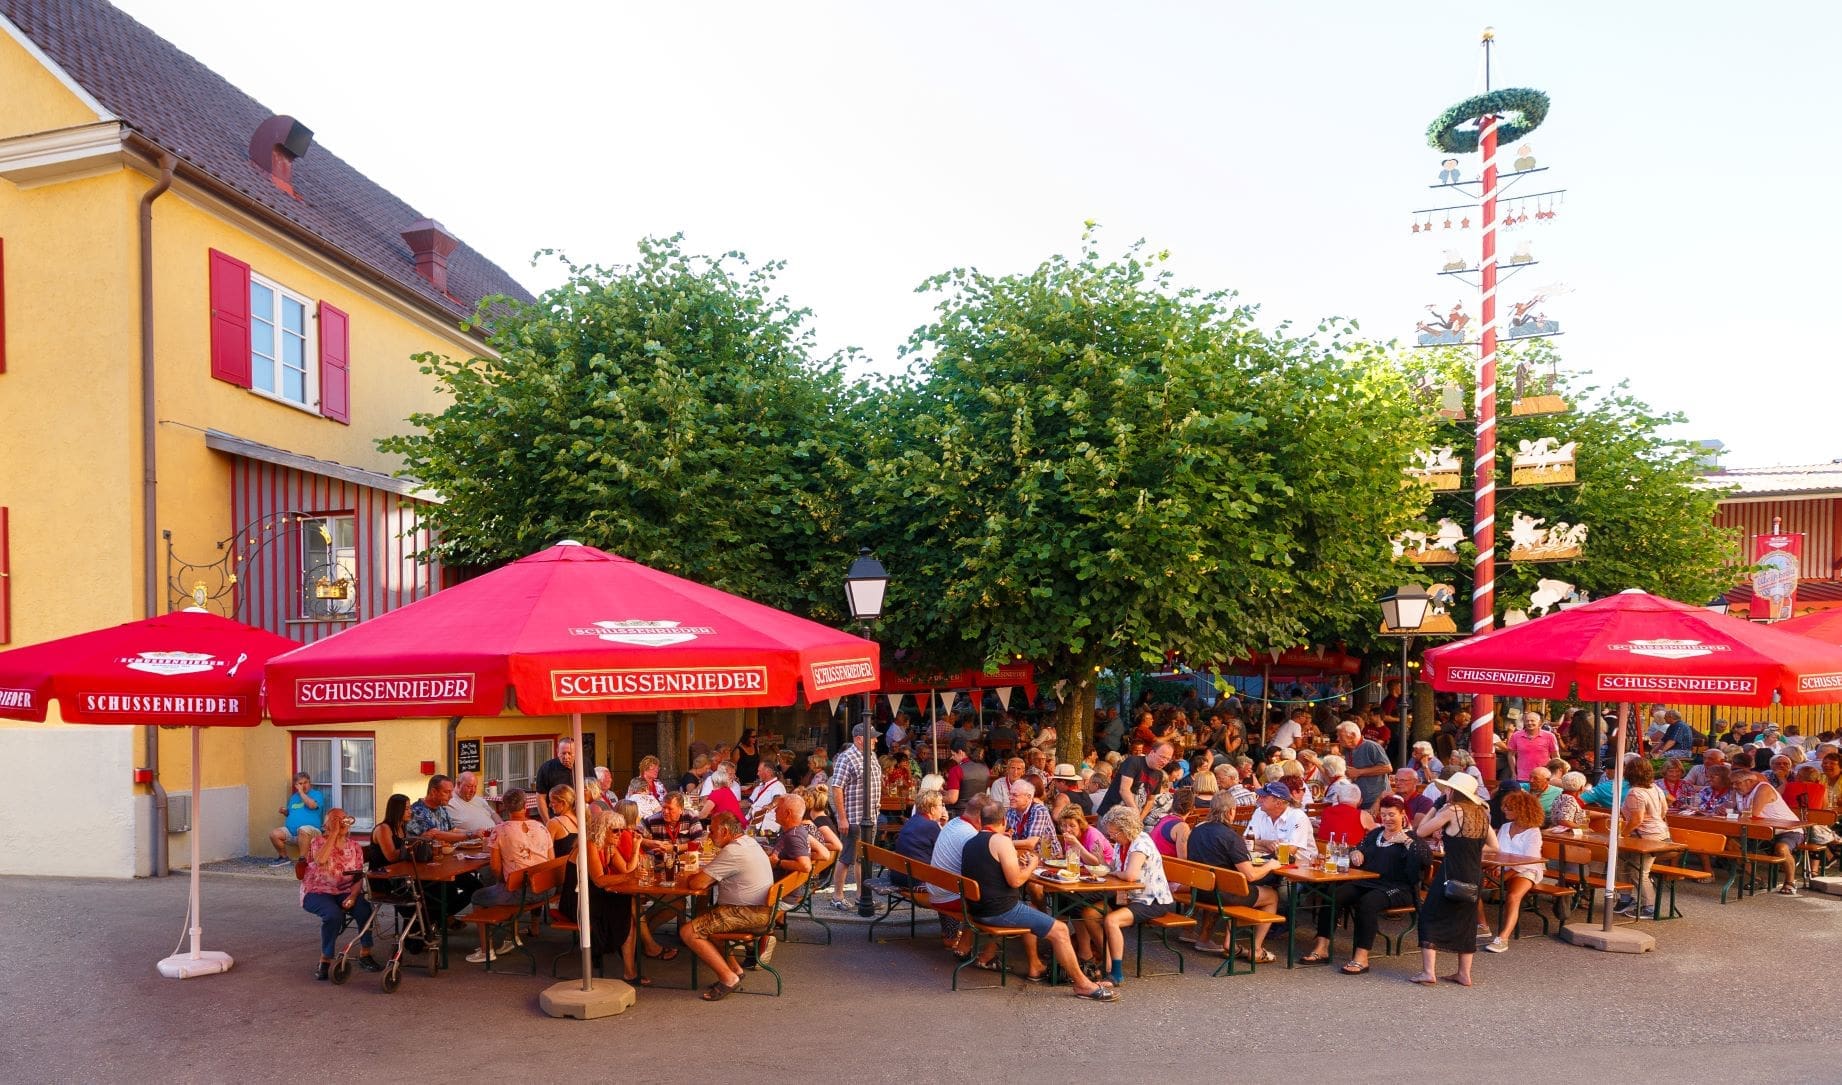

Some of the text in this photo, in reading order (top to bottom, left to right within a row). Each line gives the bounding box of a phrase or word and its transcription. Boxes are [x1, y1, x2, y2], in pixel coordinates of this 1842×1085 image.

[560, 672, 761, 695] SCHUSSENRIEDER
[815, 662, 872, 685] SCHUSSENRIEDER
[1451, 669, 1550, 685] SCHUSSENRIEDER
[301, 679, 468, 701] SCHUSSENRIEDER
[1603, 677, 1751, 692] SCHUSSENRIEDER
[87, 695, 239, 713] SCHUSSENRIEDER
